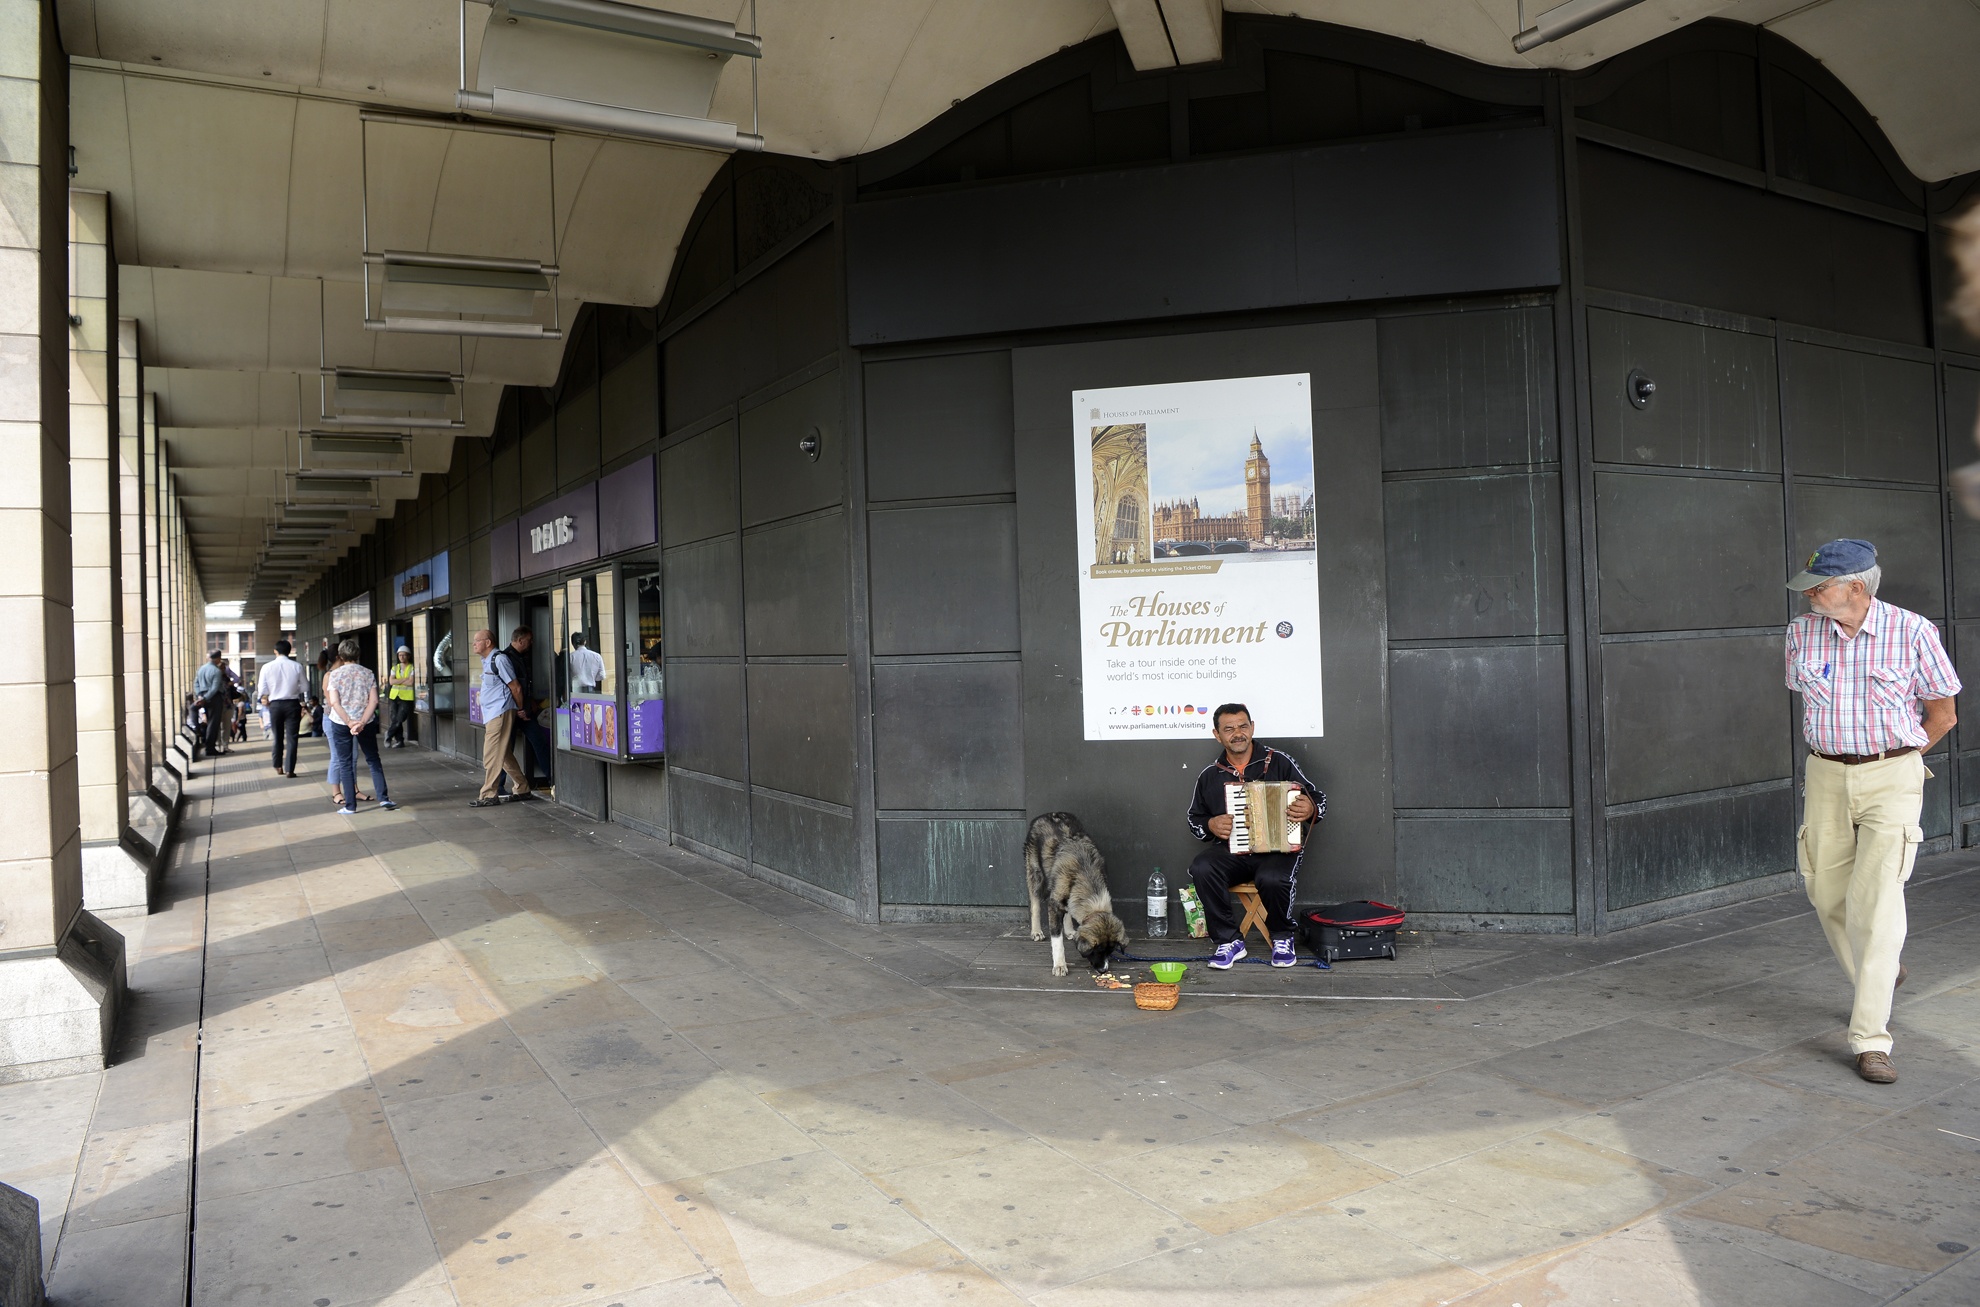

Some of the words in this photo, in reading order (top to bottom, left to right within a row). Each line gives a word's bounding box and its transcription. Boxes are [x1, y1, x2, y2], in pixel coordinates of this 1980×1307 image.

[1138, 408, 1180, 416] PARLIAMENT
[530, 515, 573, 554] TREATS
[1109, 605, 1129, 617] The
[1128, 590, 1211, 617] Houses
[1213, 601, 1228, 618] of
[1099, 619, 1268, 648] Parliament
[1106, 659, 1126, 668] Take
[1137, 659, 1156, 667] tour
[1159, 657, 1185, 667] inside
[1187, 658, 1206, 666] one
[1208, 656, 1218, 666] of
[1221, 656, 1237, 665] the
[1106, 672, 1139, 681] world's
[1142, 672, 1164, 680] most
[1167, 670, 1194, 680] iconic
[1196, 670, 1237, 680] buildings
[633, 704, 642, 750] TREATS
[1108, 722, 1206, 730] www.parliament.uk/visiting
